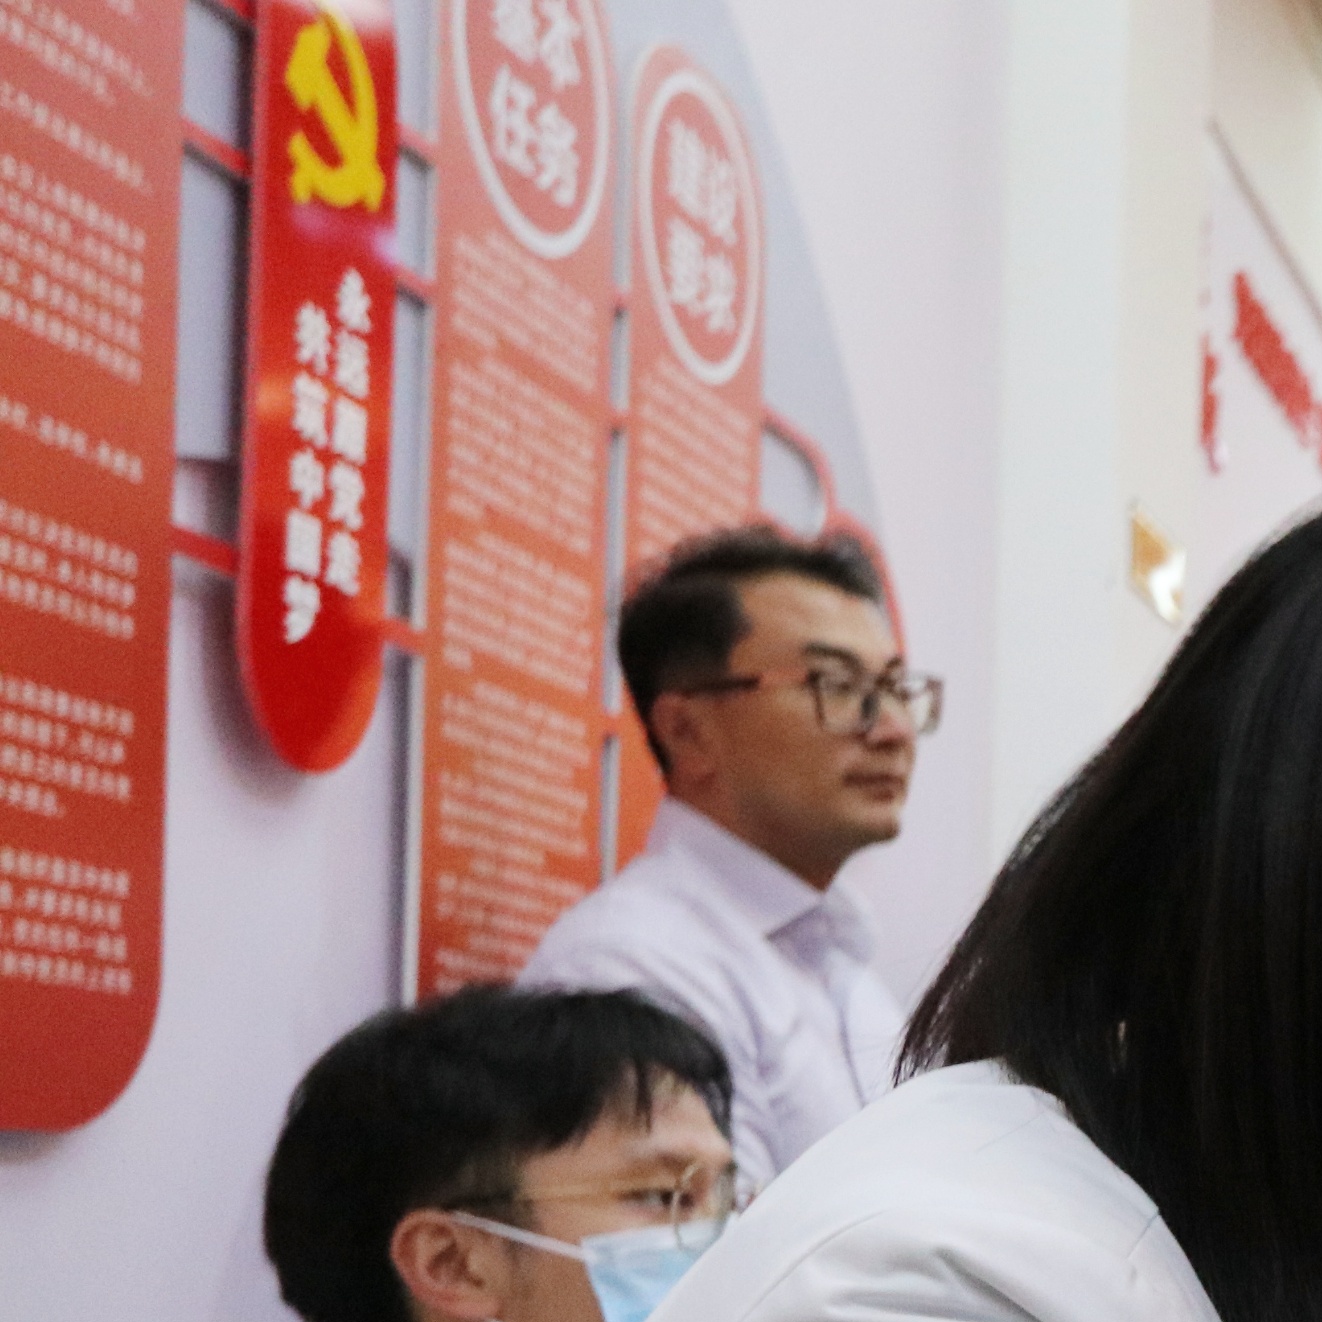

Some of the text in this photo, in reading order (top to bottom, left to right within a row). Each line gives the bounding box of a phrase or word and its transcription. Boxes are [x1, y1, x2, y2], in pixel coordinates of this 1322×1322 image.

[489, 63, 580, 208] 任务
[325, 266, 372, 597] 永远跟党走
